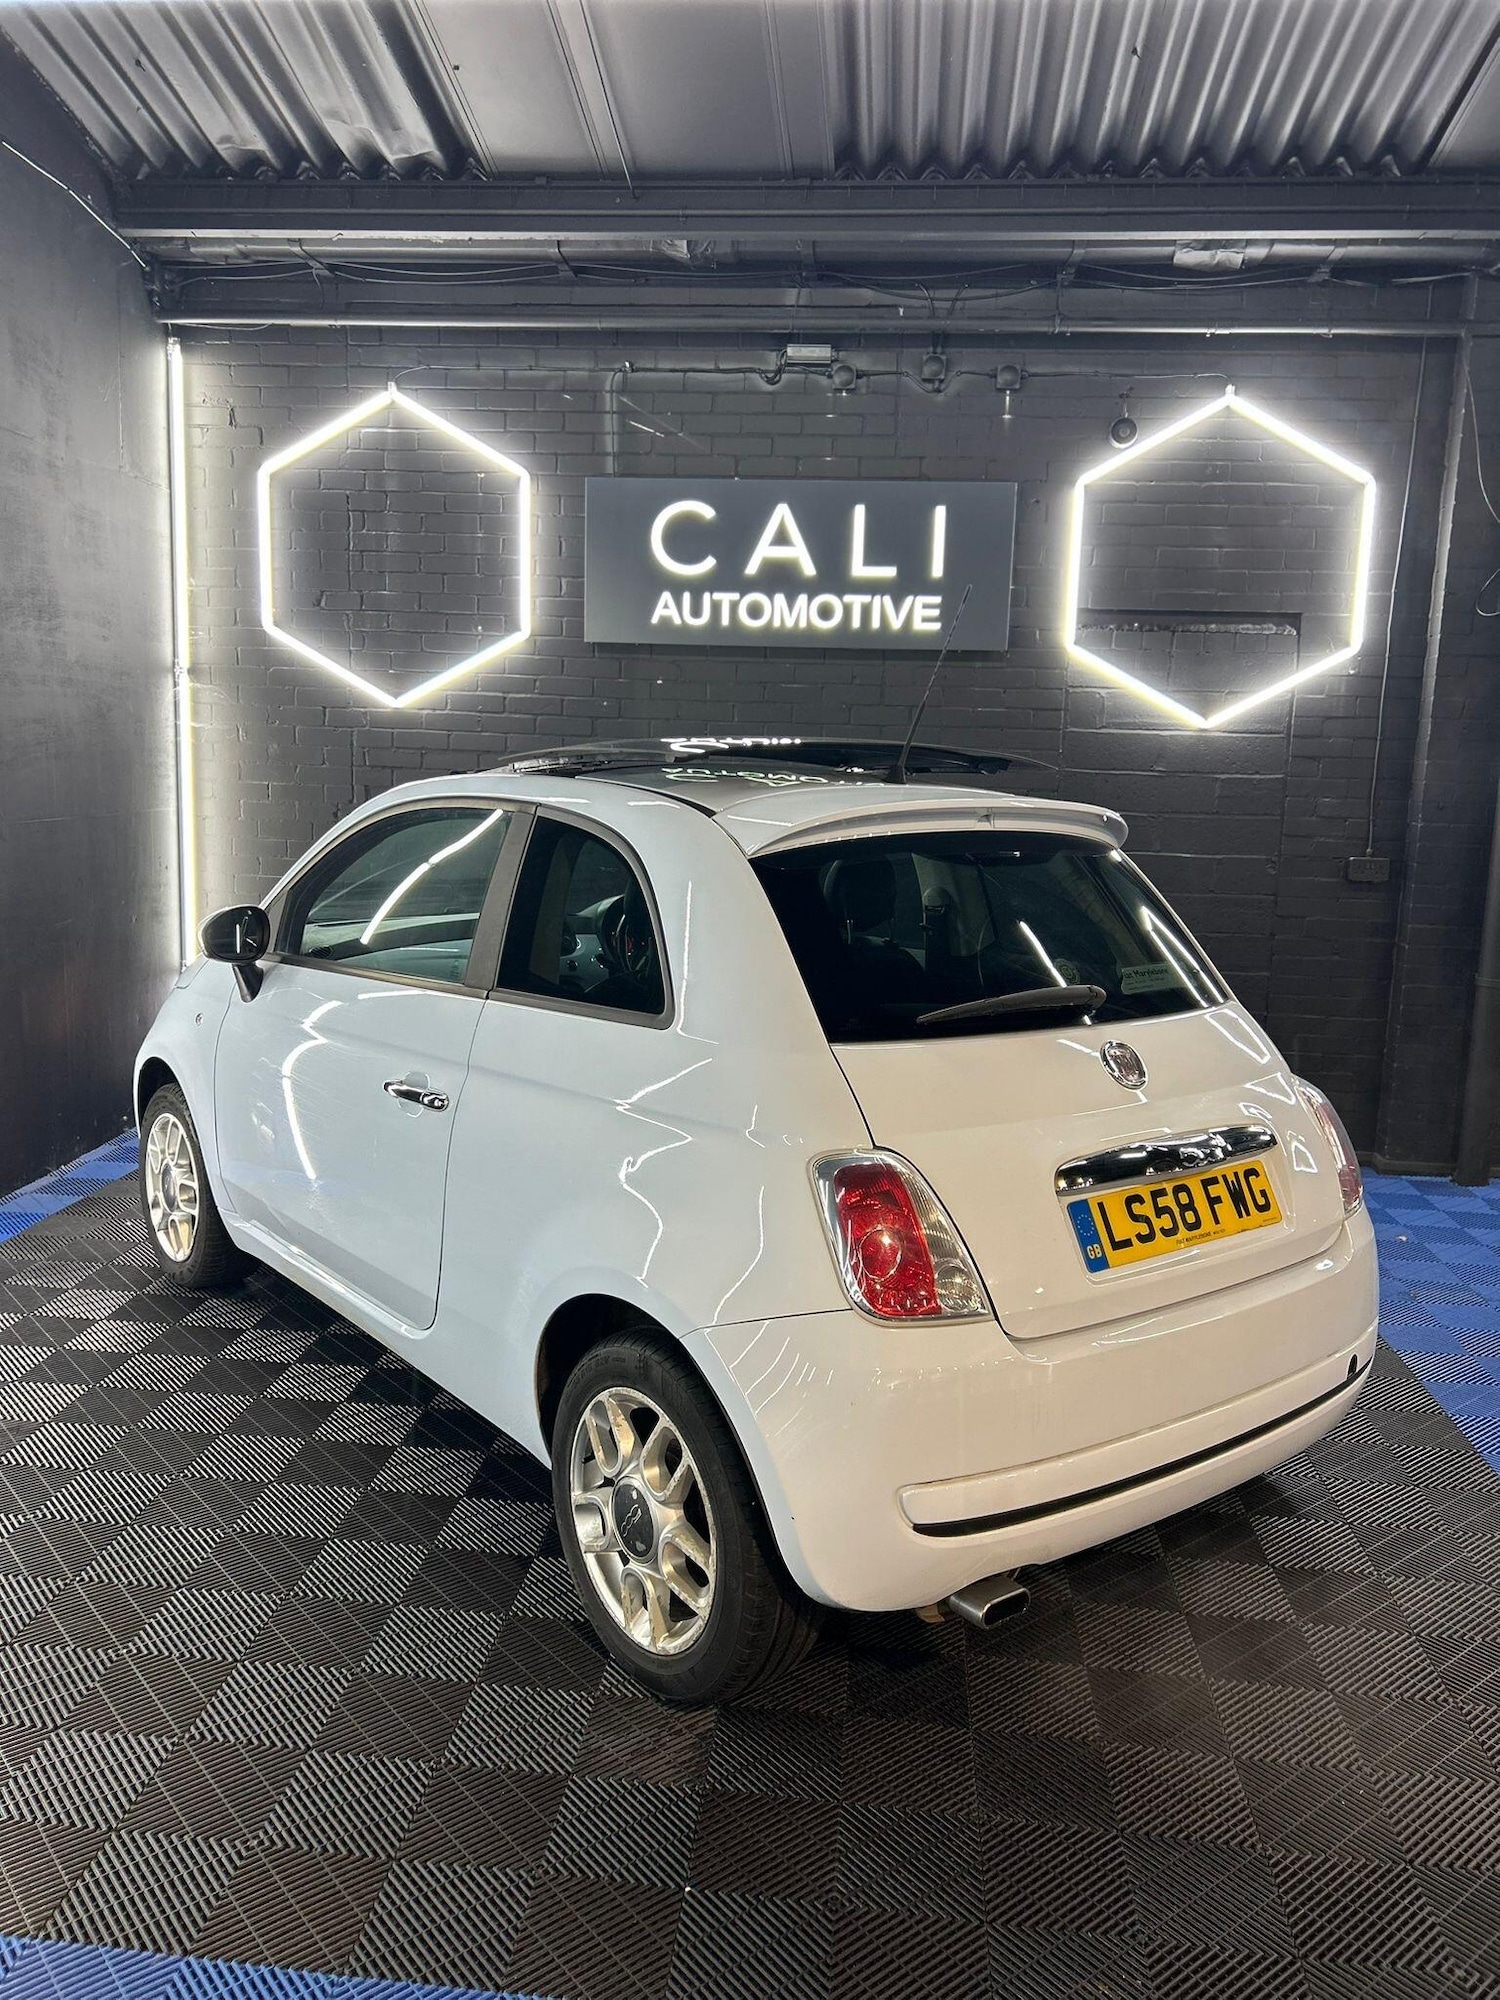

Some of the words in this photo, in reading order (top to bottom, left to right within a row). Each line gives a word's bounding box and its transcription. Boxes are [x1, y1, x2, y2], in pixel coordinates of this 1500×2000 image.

[650, 499, 947, 578] CALI
[650, 590, 943, 632] AUTOMOTIVE
[1097, 1184, 1202, 1252] LS58
[1201, 1167, 1272, 1226] FWG
[1086, 1244, 1103, 1259] GB
